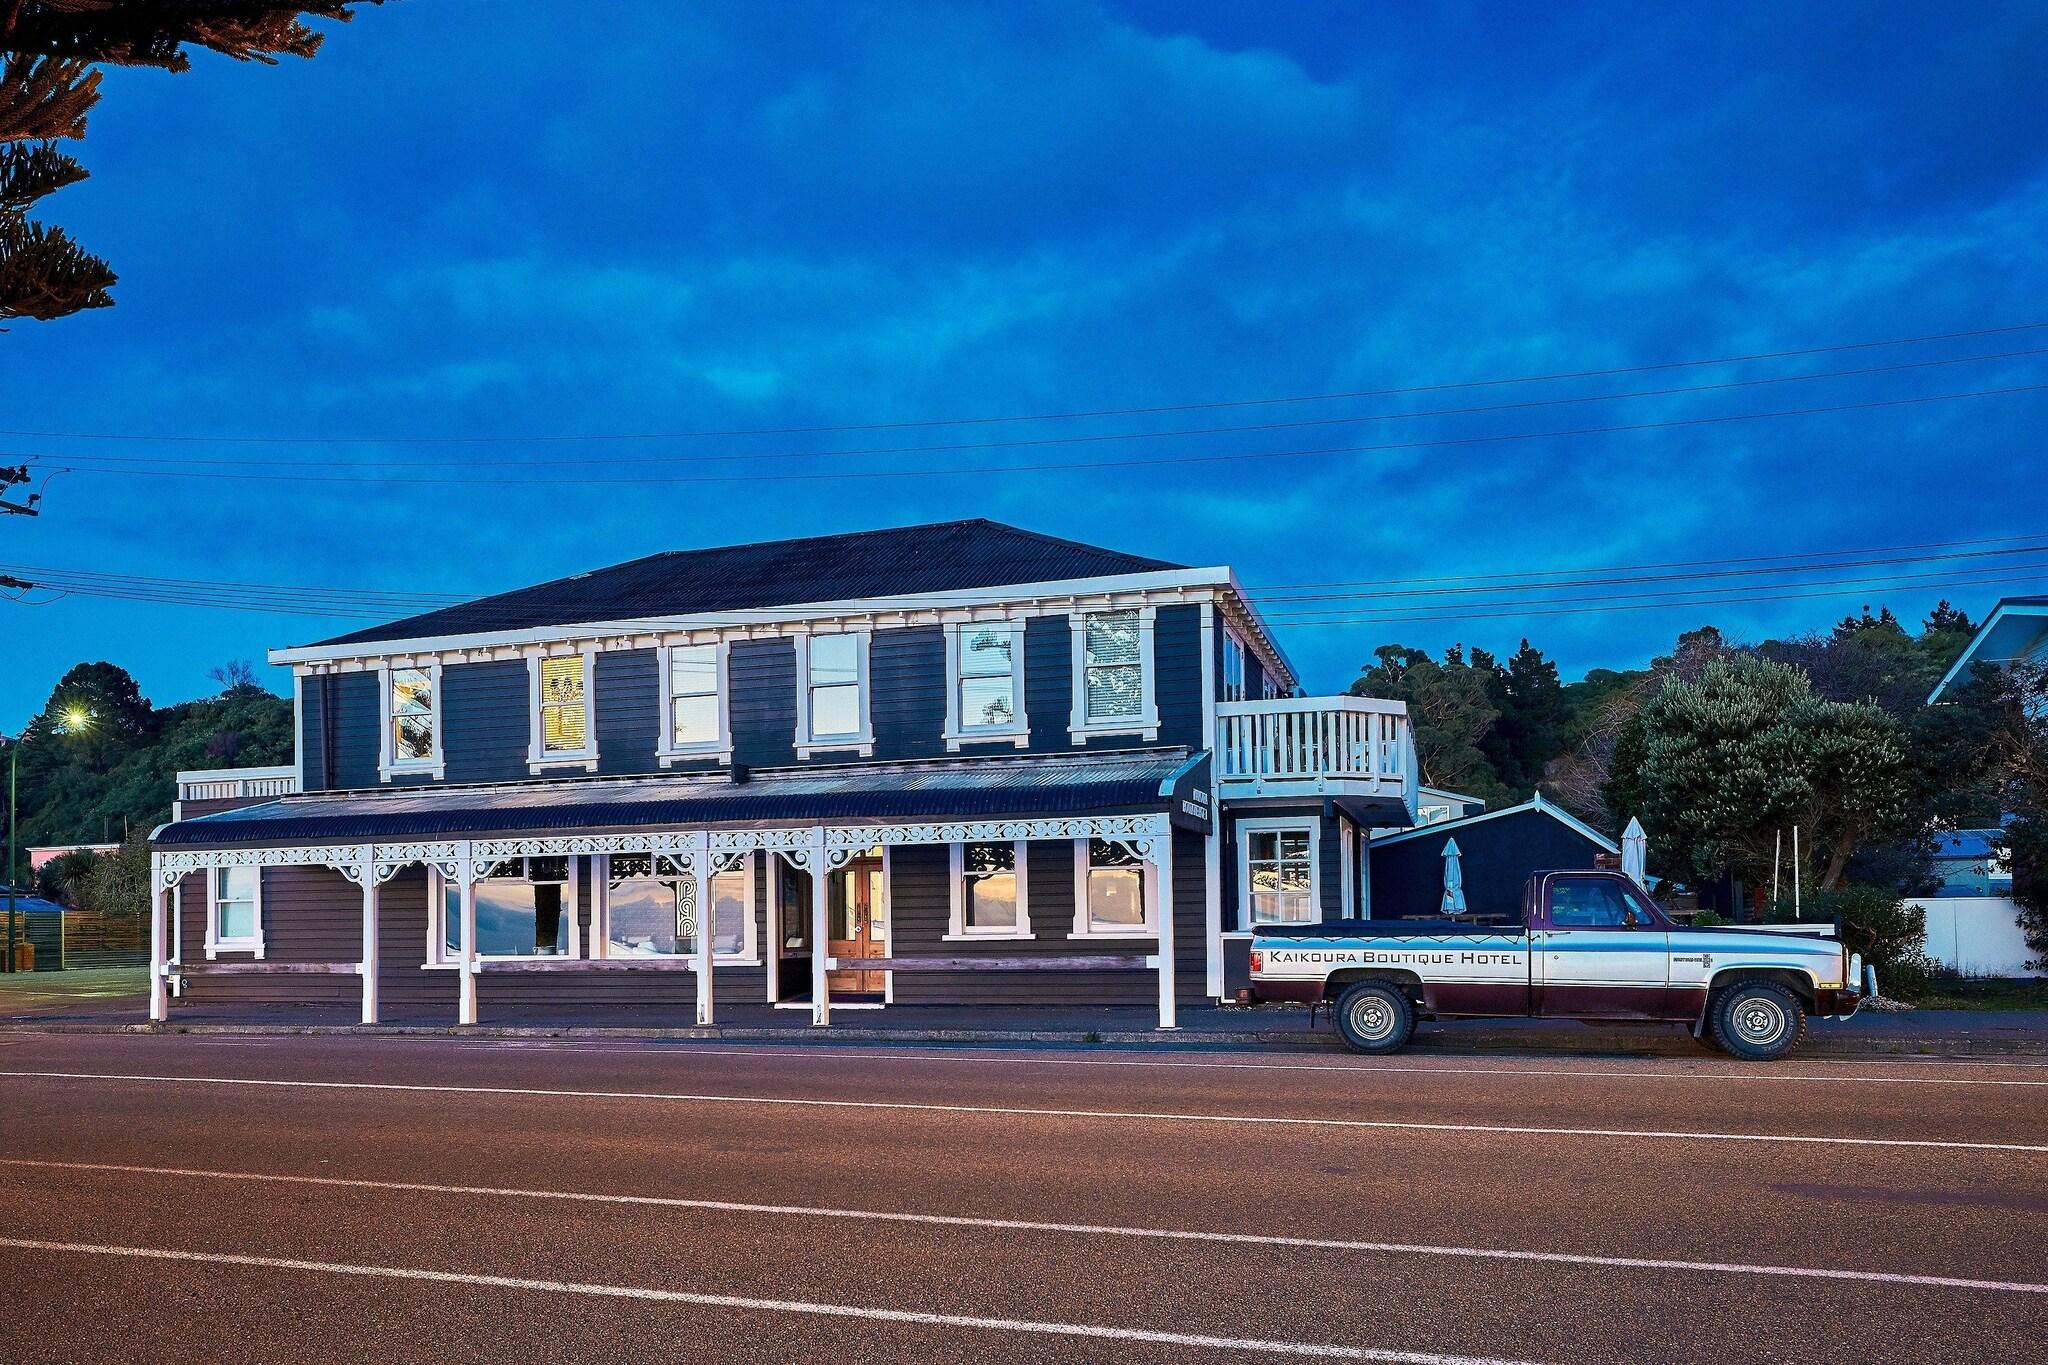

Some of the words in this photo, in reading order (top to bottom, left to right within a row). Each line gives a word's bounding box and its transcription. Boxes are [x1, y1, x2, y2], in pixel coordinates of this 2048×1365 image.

[1270, 951, 1357, 963] KAIKOURA
[1363, 952, 1453, 965] BOUTIQUE
[1461, 953, 1522, 965] HOTEL
